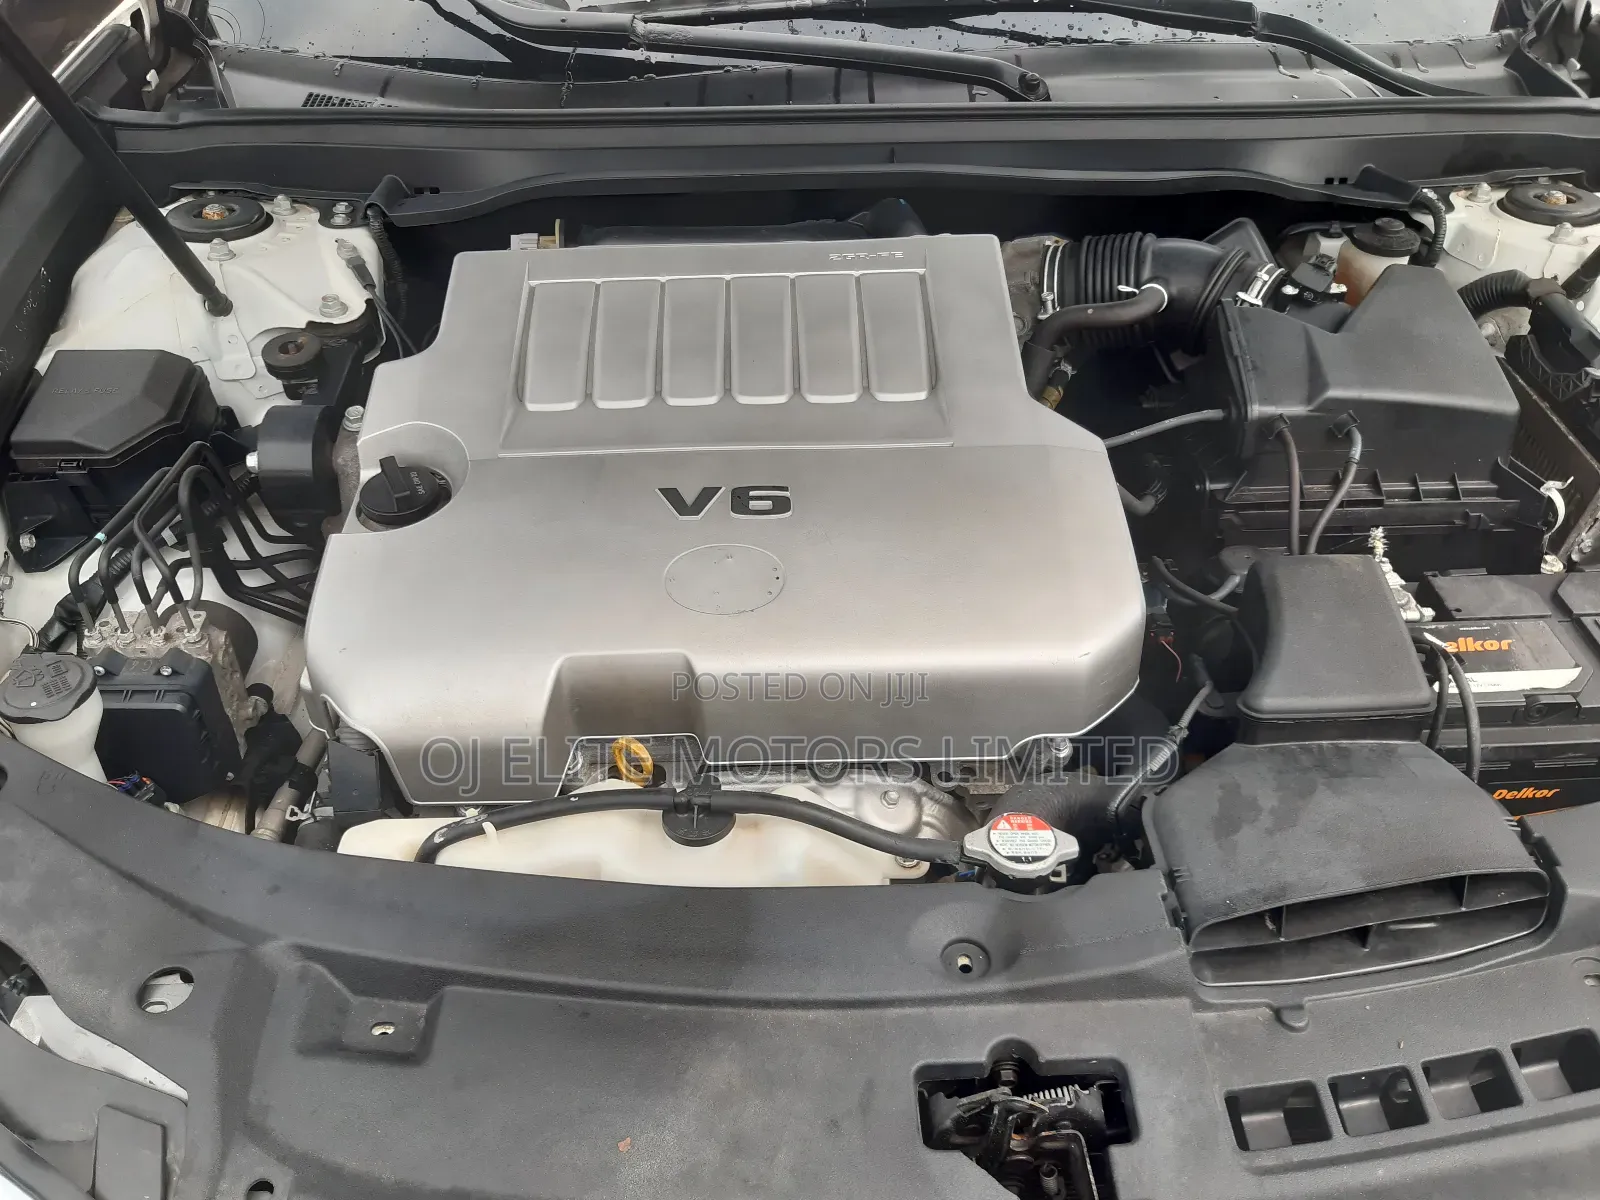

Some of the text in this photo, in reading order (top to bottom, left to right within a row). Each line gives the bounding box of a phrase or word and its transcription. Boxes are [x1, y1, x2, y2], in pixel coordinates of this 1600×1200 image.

[655, 485, 793, 521] V6
[1444, 636, 1513, 653] elkor
[1492, 786, 1561, 800] Delkor
